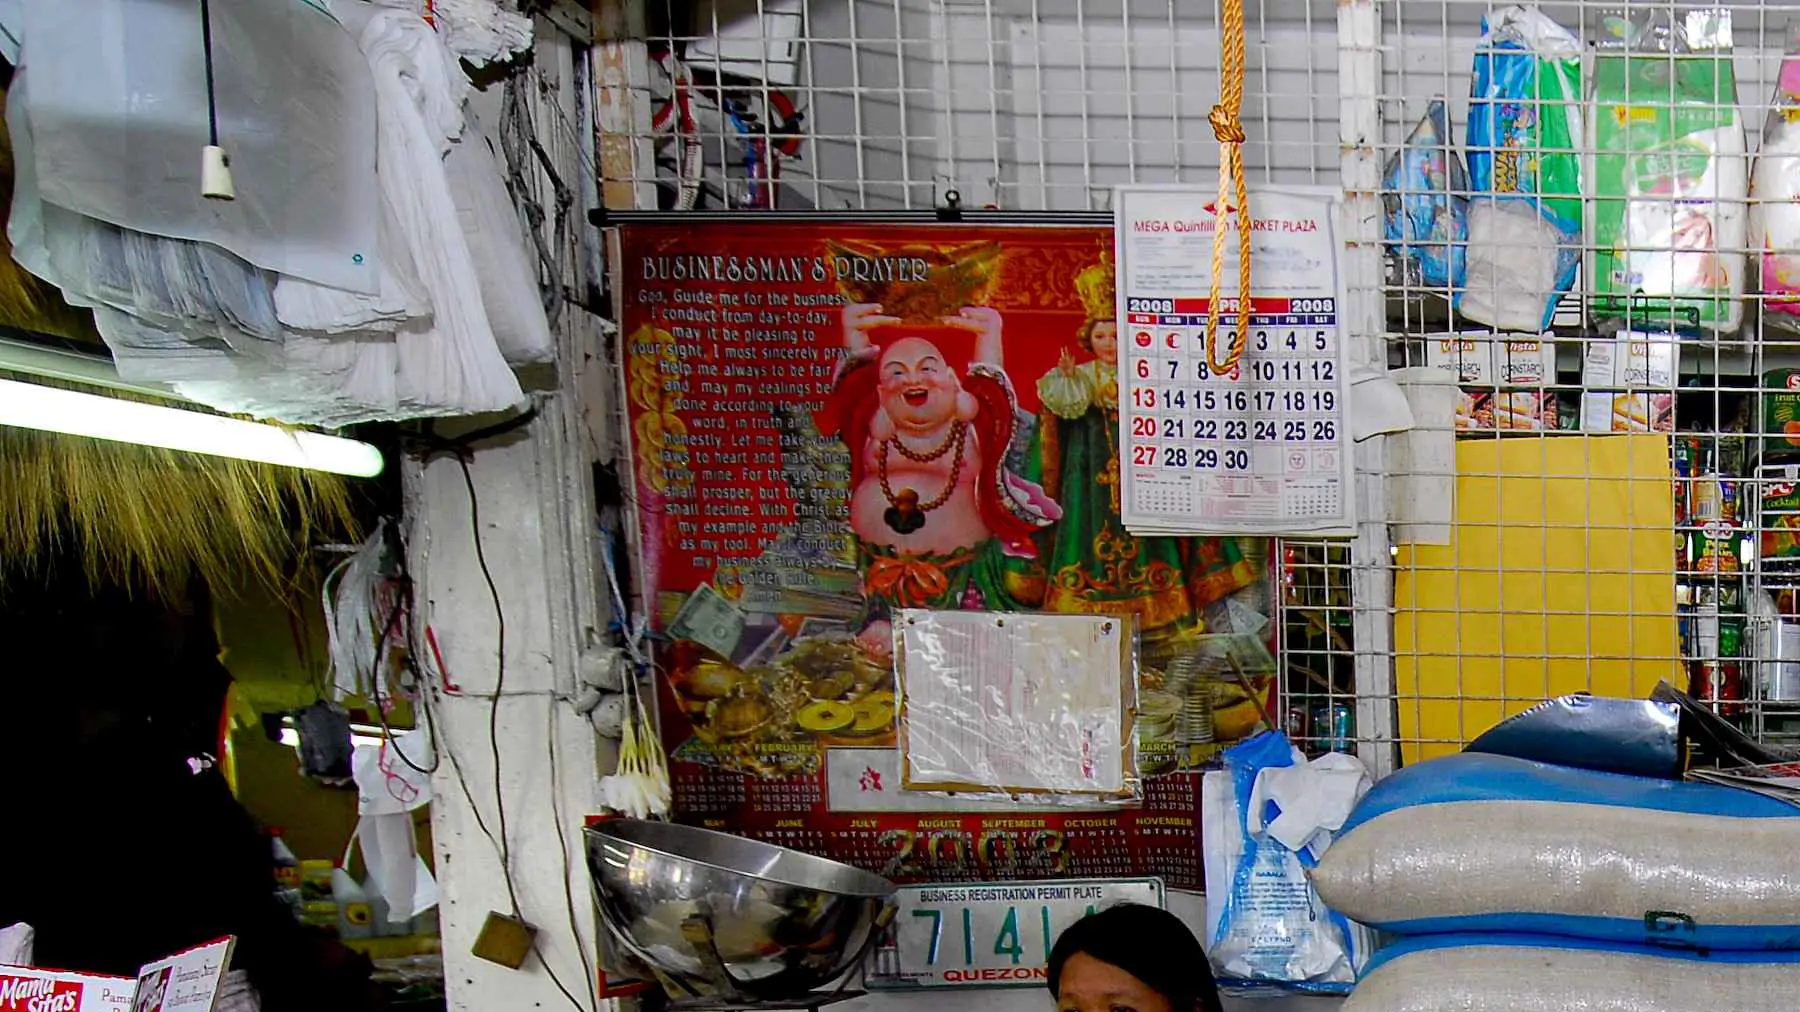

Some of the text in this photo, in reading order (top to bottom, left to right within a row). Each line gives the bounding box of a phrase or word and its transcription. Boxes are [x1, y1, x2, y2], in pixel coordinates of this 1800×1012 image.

[1134, 220, 1169, 232] MEGA
[1283, 220, 1317, 232] PLAZA
[643, 256, 929, 283] BUSINESSMAN'S PRAYER
[673, 290, 713, 304] Guide
[719, 292, 740, 305] me
[745, 291, 763, 305] for
[768, 291, 789, 305] the
[1130, 300, 1172, 311] 2008
[1292, 300, 1333, 312] 2008
[663, 307, 717, 322] conduct
[722, 309, 754, 323] from
[672, 327, 705, 342] may
[723, 328, 739, 342] be
[745, 328, 797, 344] pleasing
[803, 329, 816, 341] to
[1196, 331, 1205, 350] 1
[1256, 331, 1268, 351] 3
[1285, 331, 1297, 350] 4
[1315, 331, 1326, 350] 5
[725, 346, 757, 360] most
[763, 347, 819, 361] sincerely
[660, 360, 831, 378] Help me always to be fair
[1137, 359, 1149, 379] 6
[1167, 360, 1178, 379] 7
[1198, 361, 1209, 381] 8
[1253, 361, 1275, 381] 10
[1282, 361, 1302, 380] 11
[1311, 361, 1333, 380] 12
[701, 383, 729, 397] may
[735, 384, 753, 397] my
[758, 382, 812, 398] dealings
[1133, 387, 1334, 411] 13 14 15 16 17 18 19
[1133, 416, 1335, 441] 20 21 22 23 24 25 26
[756, 435, 773, 447] me
[1134, 446, 1248, 470] 27 28 29 30
[702, 487, 754, 501] prosper,
[759, 486, 780, 499] but
[785, 486, 805, 499] the
[665, 502, 700, 516] shall
[759, 502, 788, 516] With
[836, 506, 849, 516] as
[850, 819, 878, 828] JULY
[917, 819, 962, 828] AUGUST
[981, 819, 1046, 828] SEPTEMBER
[1064, 818, 1118, 828] OCTOBER
[1136, 817, 1193, 827] NOVEMBER
[920, 886, 1103, 902] BUSINESS REGISTRATION PERMIT PLATE
[912, 905, 1097, 965] 7141
[943, 968, 1049, 982] QUEZON
[0, 977, 56, 1009] Mama
